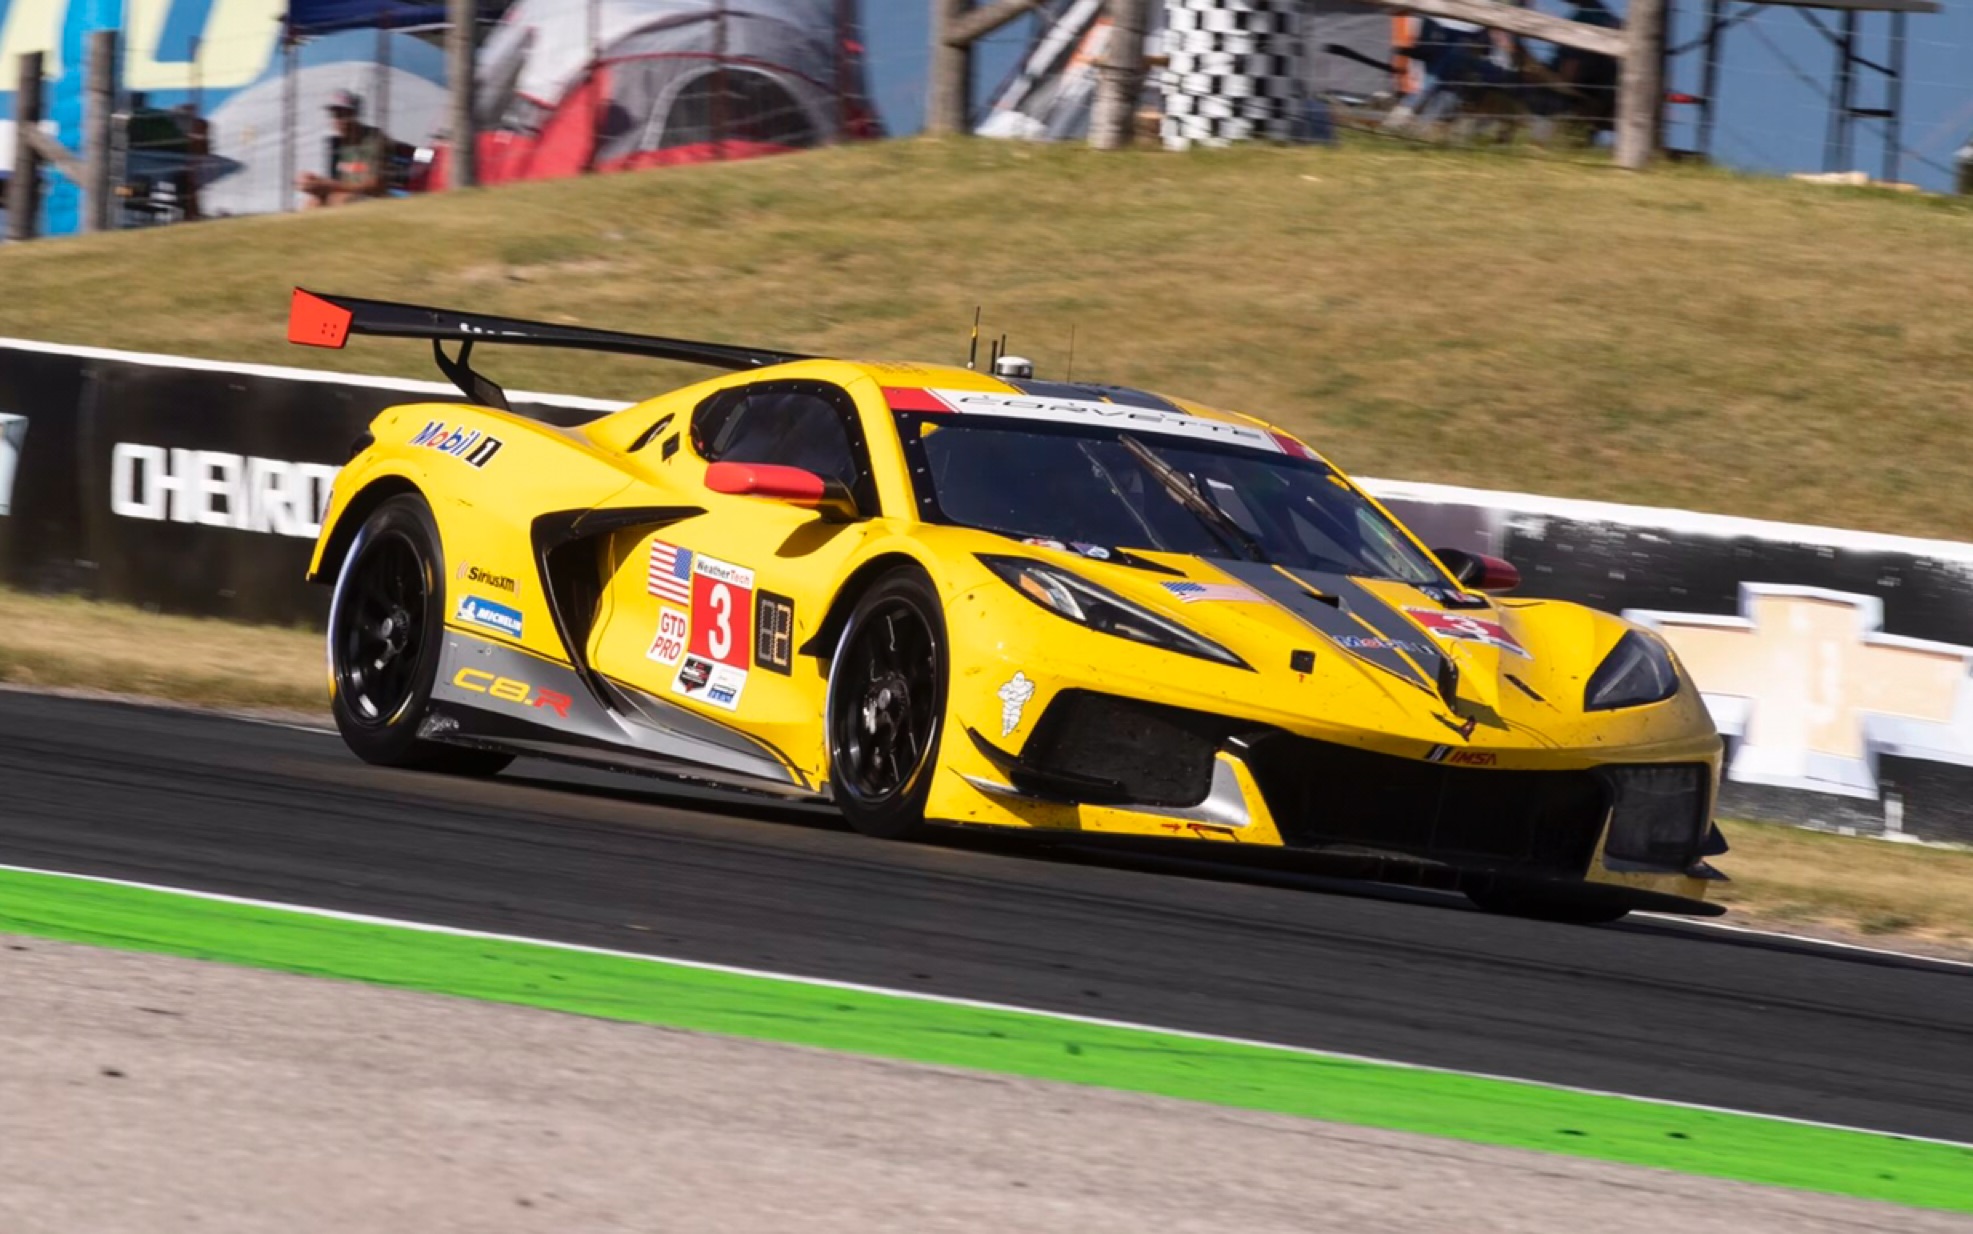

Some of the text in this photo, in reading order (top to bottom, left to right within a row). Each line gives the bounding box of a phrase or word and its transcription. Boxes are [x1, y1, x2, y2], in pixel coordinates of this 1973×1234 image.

[960, 394, 1263, 440] CORVETTE
[408, 420, 503, 468] Mobil 1
[697, 559, 750, 585] WeatherTech
[661, 612, 686, 639] GTD
[708, 583, 732, 660] 3
[651, 636, 681, 662] PRO
[1450, 750, 1497, 765] IMSA
